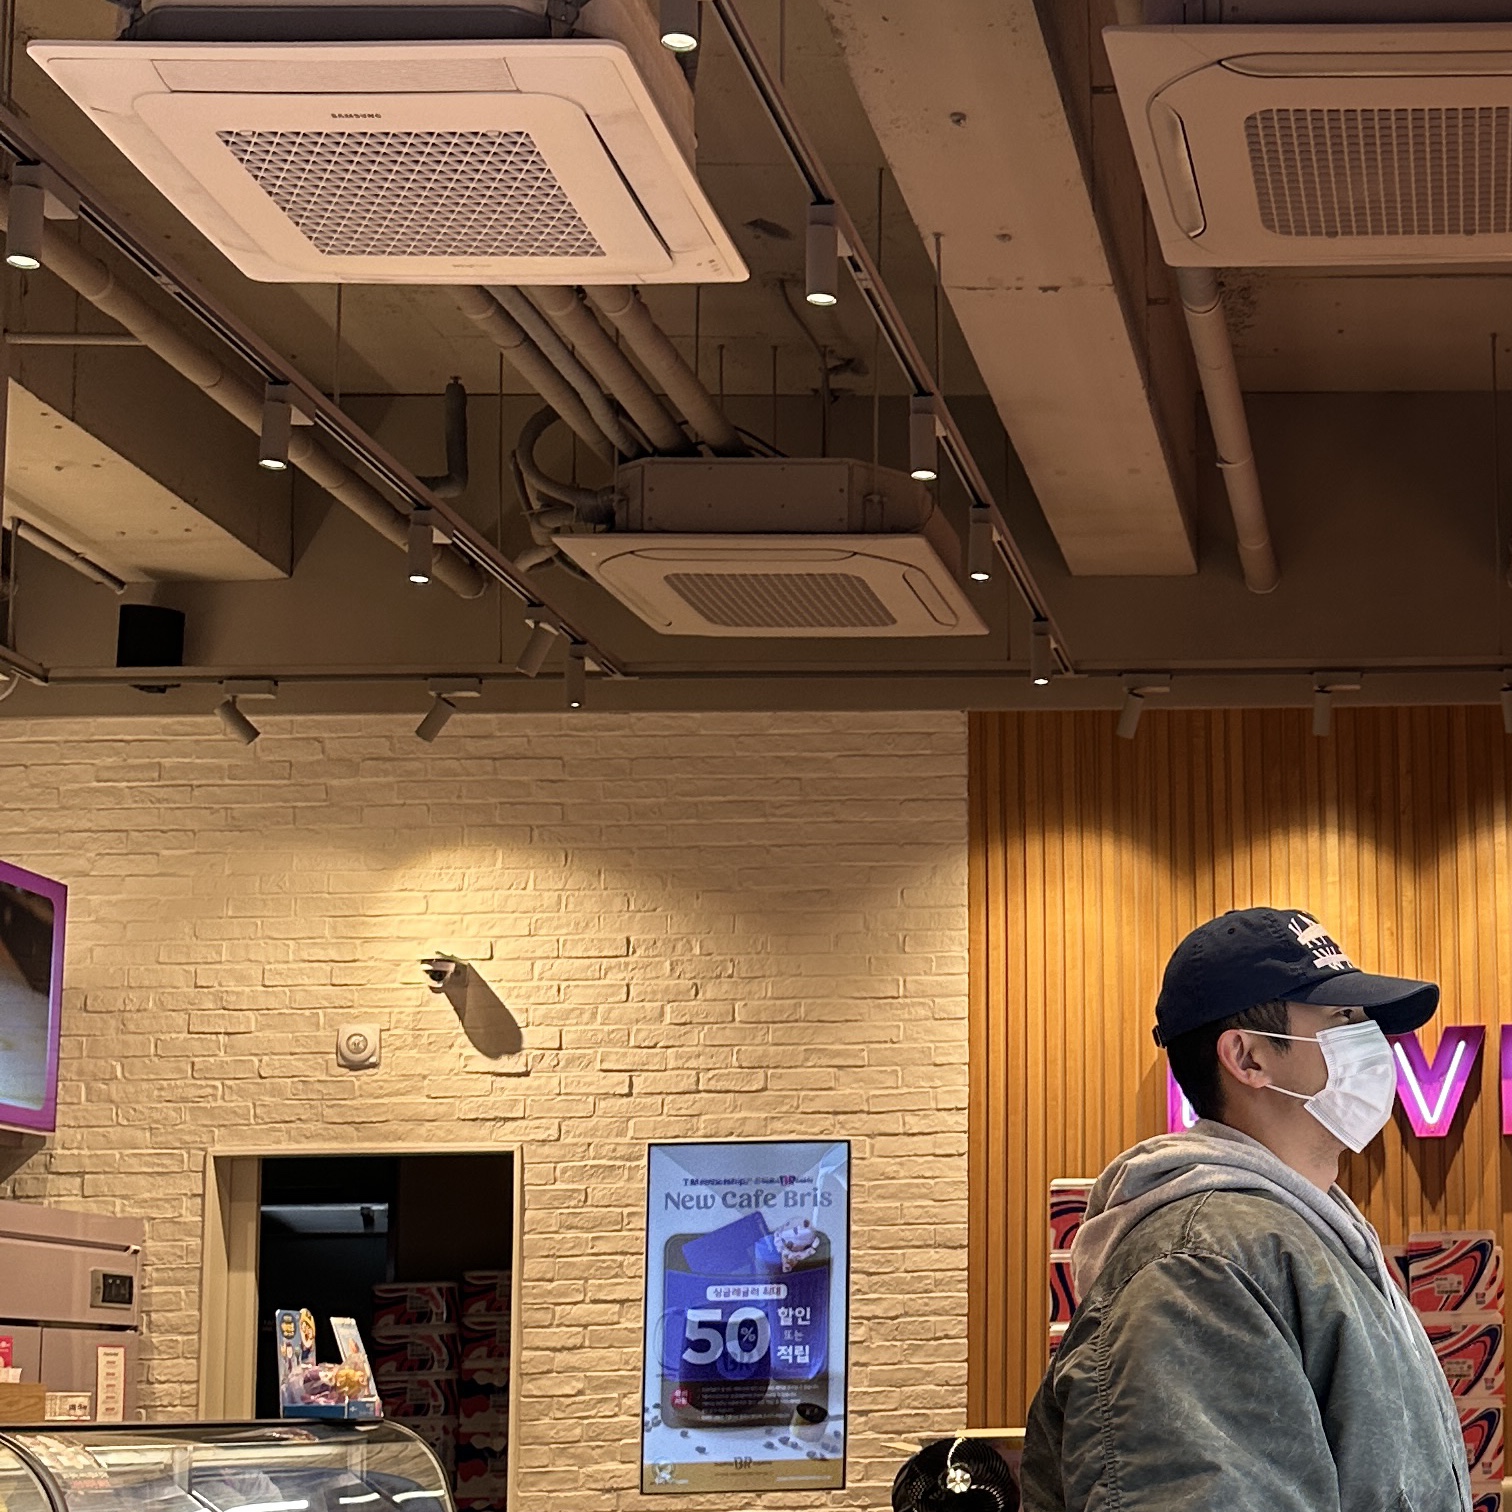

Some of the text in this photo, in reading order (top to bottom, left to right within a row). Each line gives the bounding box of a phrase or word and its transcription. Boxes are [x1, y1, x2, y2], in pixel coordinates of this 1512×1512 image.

[664, 1187, 833, 1210] New Cafe Bris
[777, 1306, 811, 1327] 할인
[777, 1345, 810, 1364] 적립
